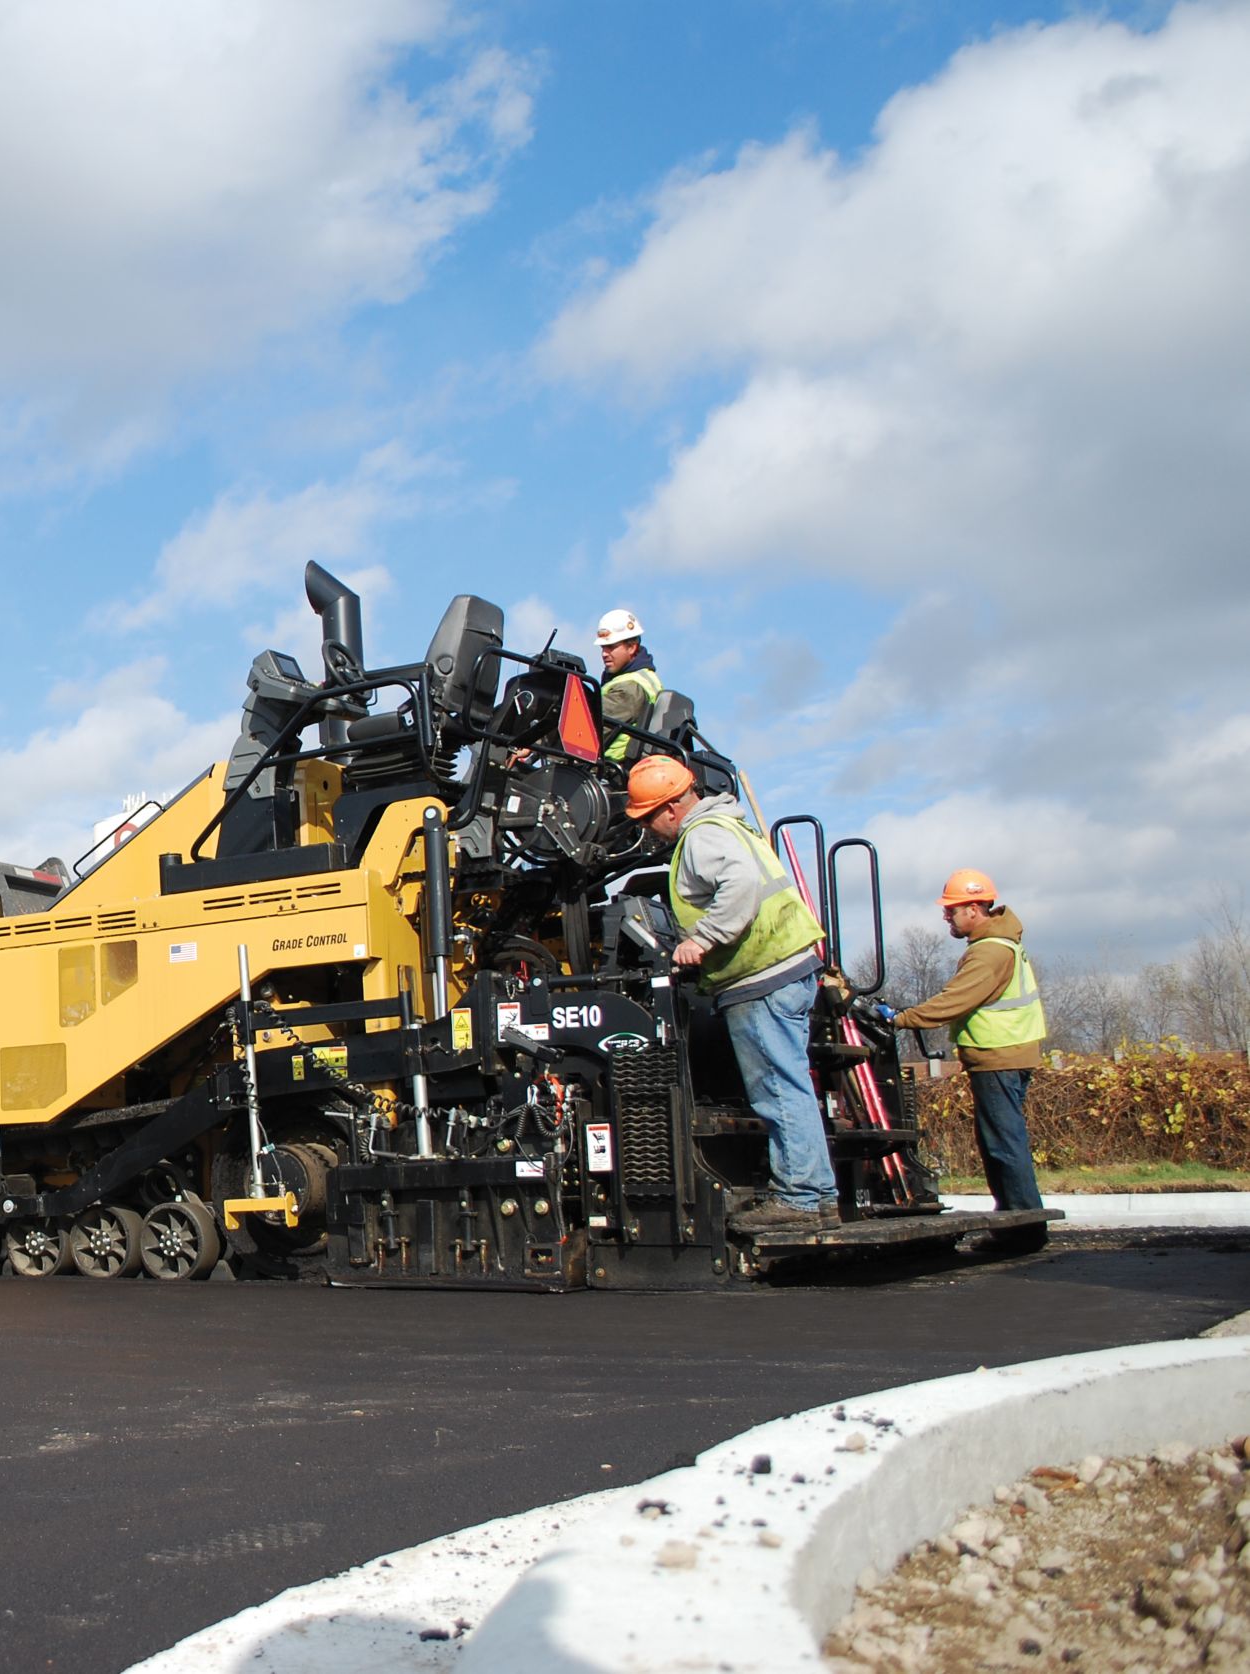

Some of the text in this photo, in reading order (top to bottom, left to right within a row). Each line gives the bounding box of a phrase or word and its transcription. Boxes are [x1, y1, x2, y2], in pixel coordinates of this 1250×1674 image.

[272, 933, 347, 951] GRADE CONTROL
[552, 1005, 601, 1028] SE10
